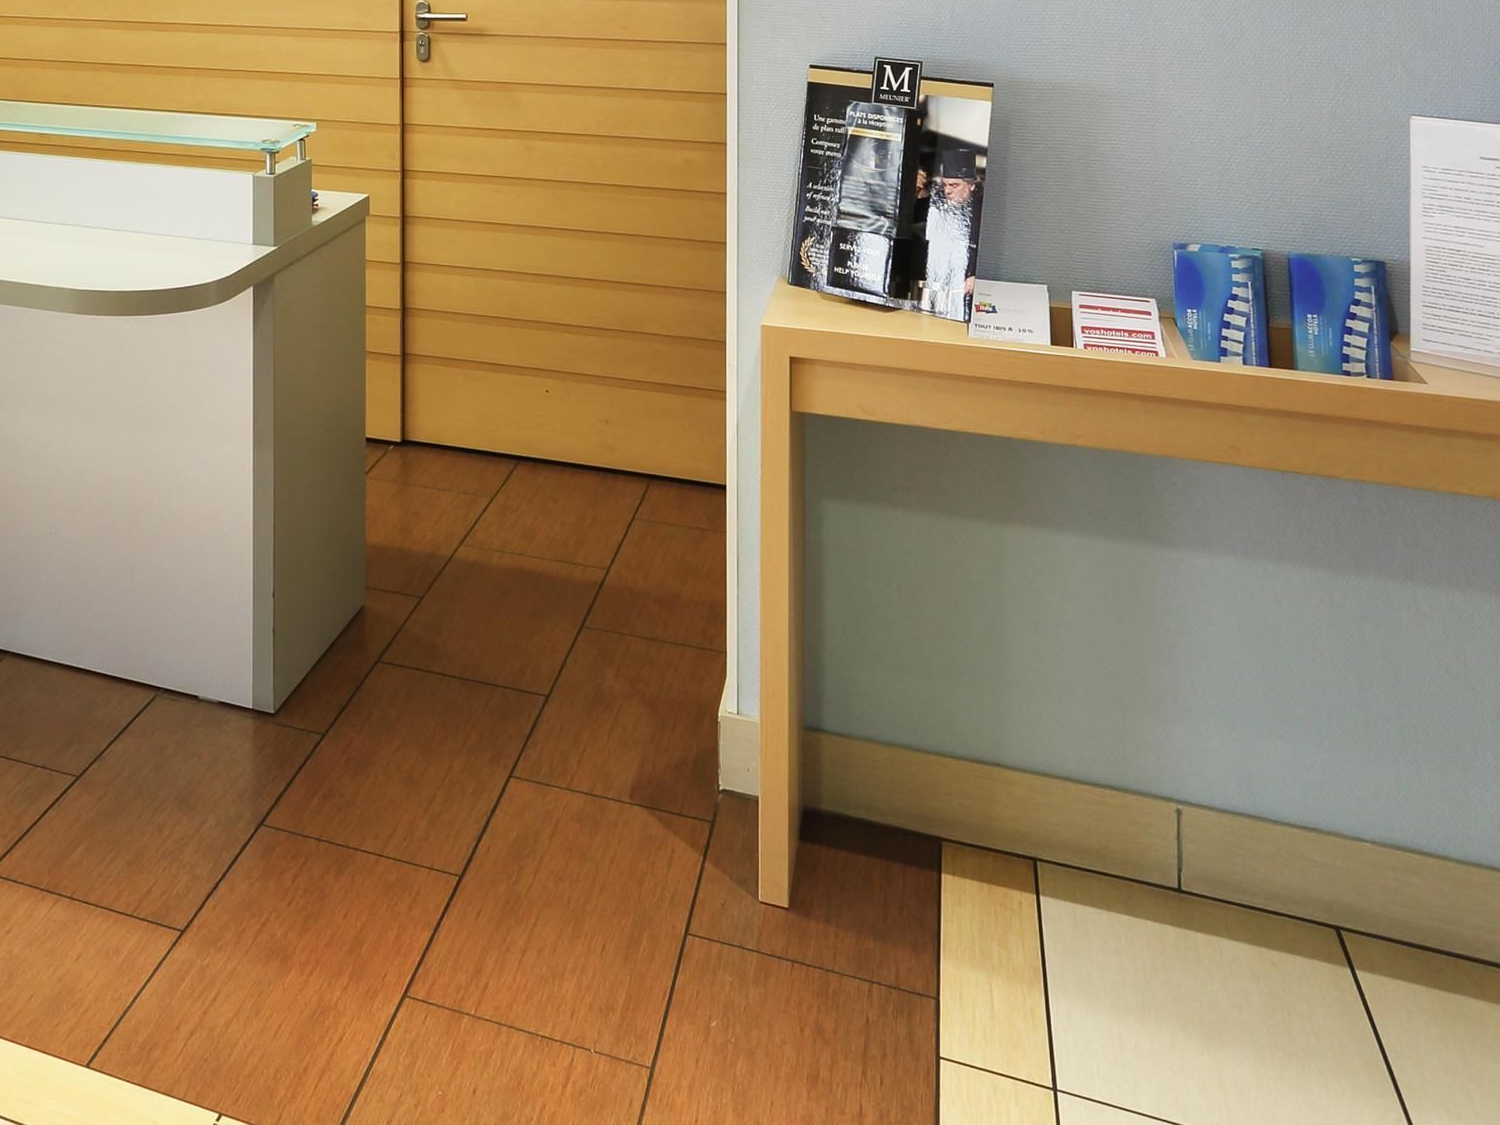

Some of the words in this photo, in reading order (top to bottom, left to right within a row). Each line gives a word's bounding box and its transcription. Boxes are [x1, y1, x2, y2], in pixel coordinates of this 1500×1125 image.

[880, 65, 913, 93] M
[880, 94, 910, 103] MEUNIER
[814, 114, 826, 122] Une
[850, 111, 867, 119] PLATS
[834, 267, 849, 275] HELP
[1084, 327, 1153, 340] voshotels.com
